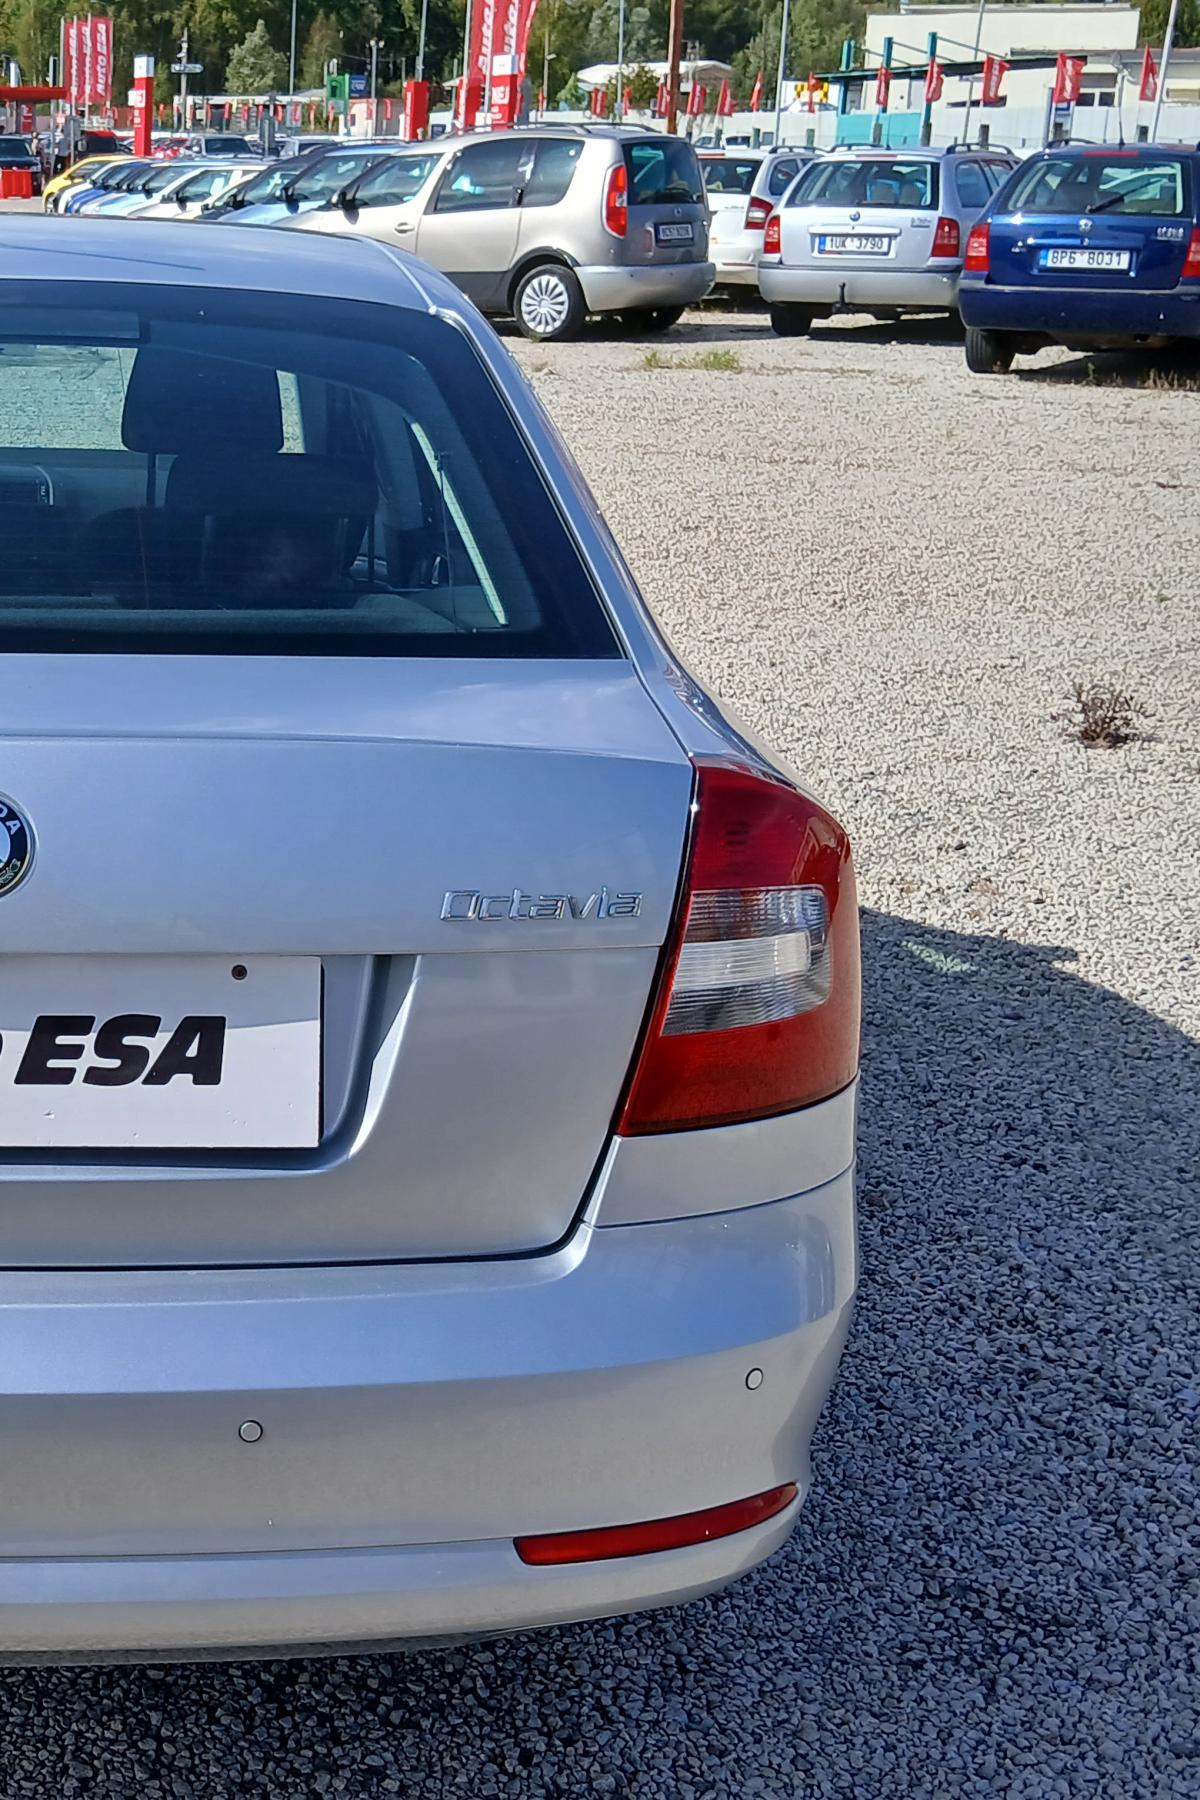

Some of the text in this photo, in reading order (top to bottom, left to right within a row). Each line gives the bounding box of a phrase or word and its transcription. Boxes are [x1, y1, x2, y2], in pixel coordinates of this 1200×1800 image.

[855, 236, 884, 250] 3790
[1051, 249, 1123, 267] 8P6 8031
[440, 884, 644, 922] Octavia
[13, 1013, 227, 1087] ESA
